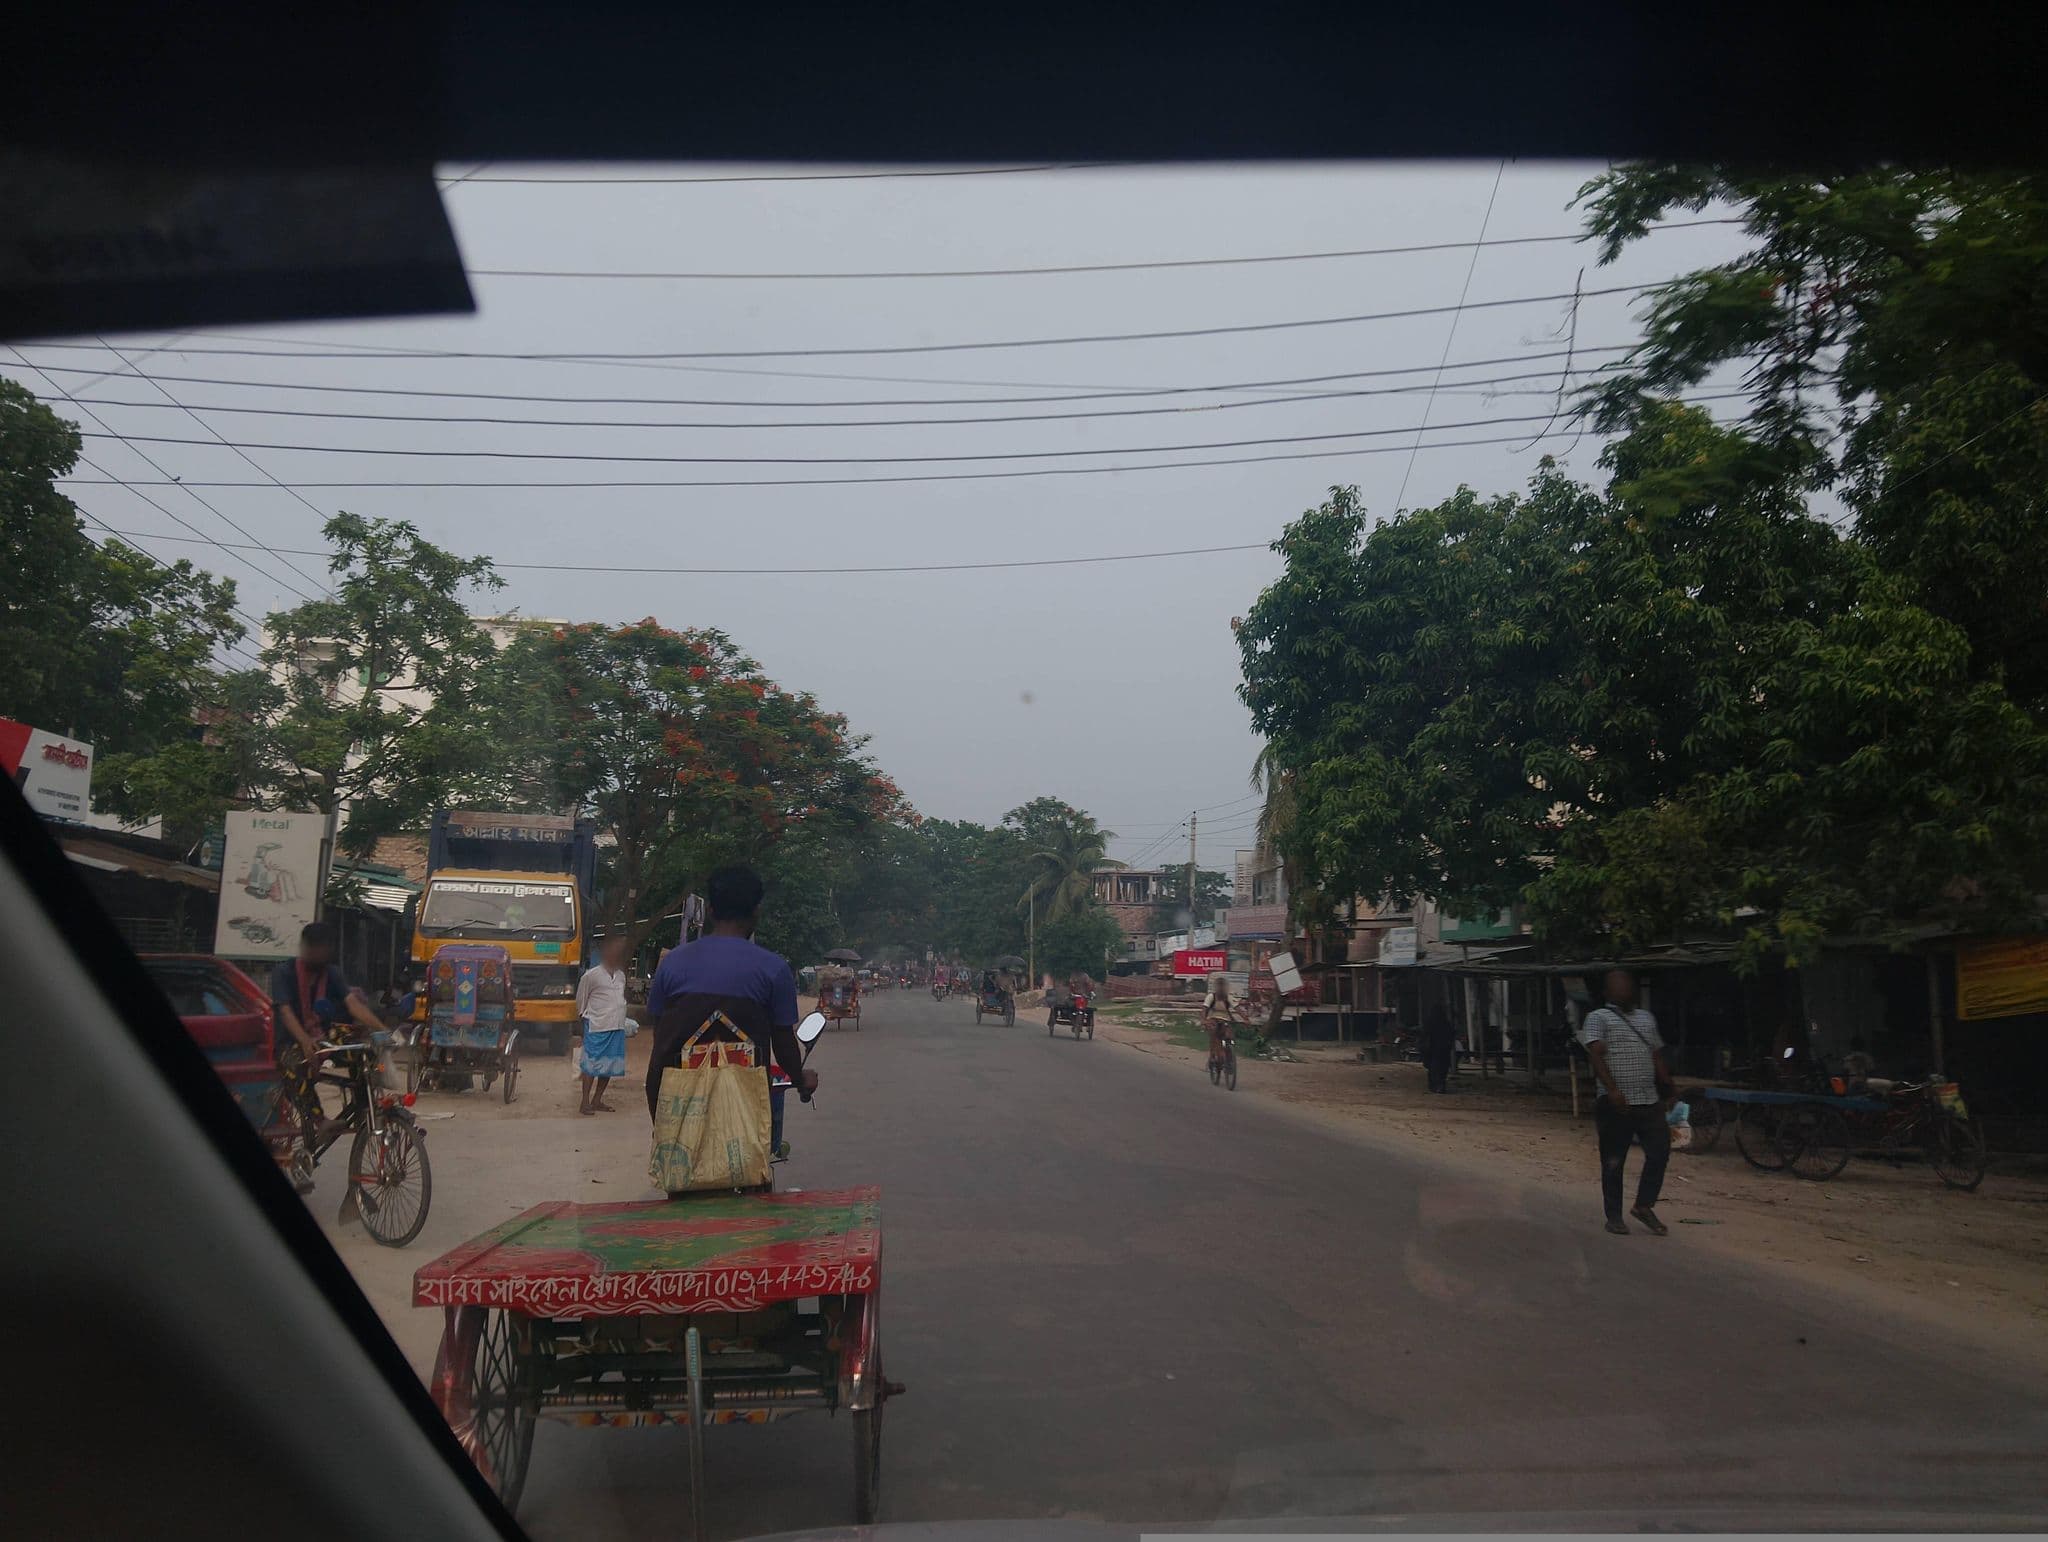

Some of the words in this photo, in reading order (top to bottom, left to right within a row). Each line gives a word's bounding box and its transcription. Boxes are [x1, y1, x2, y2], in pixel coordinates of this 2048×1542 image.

[1188, 956, 1224, 968] HATIM
[418, 1273, 489, 1304] হাবিব
[487, 1272, 584, 1304] সাইকেল
